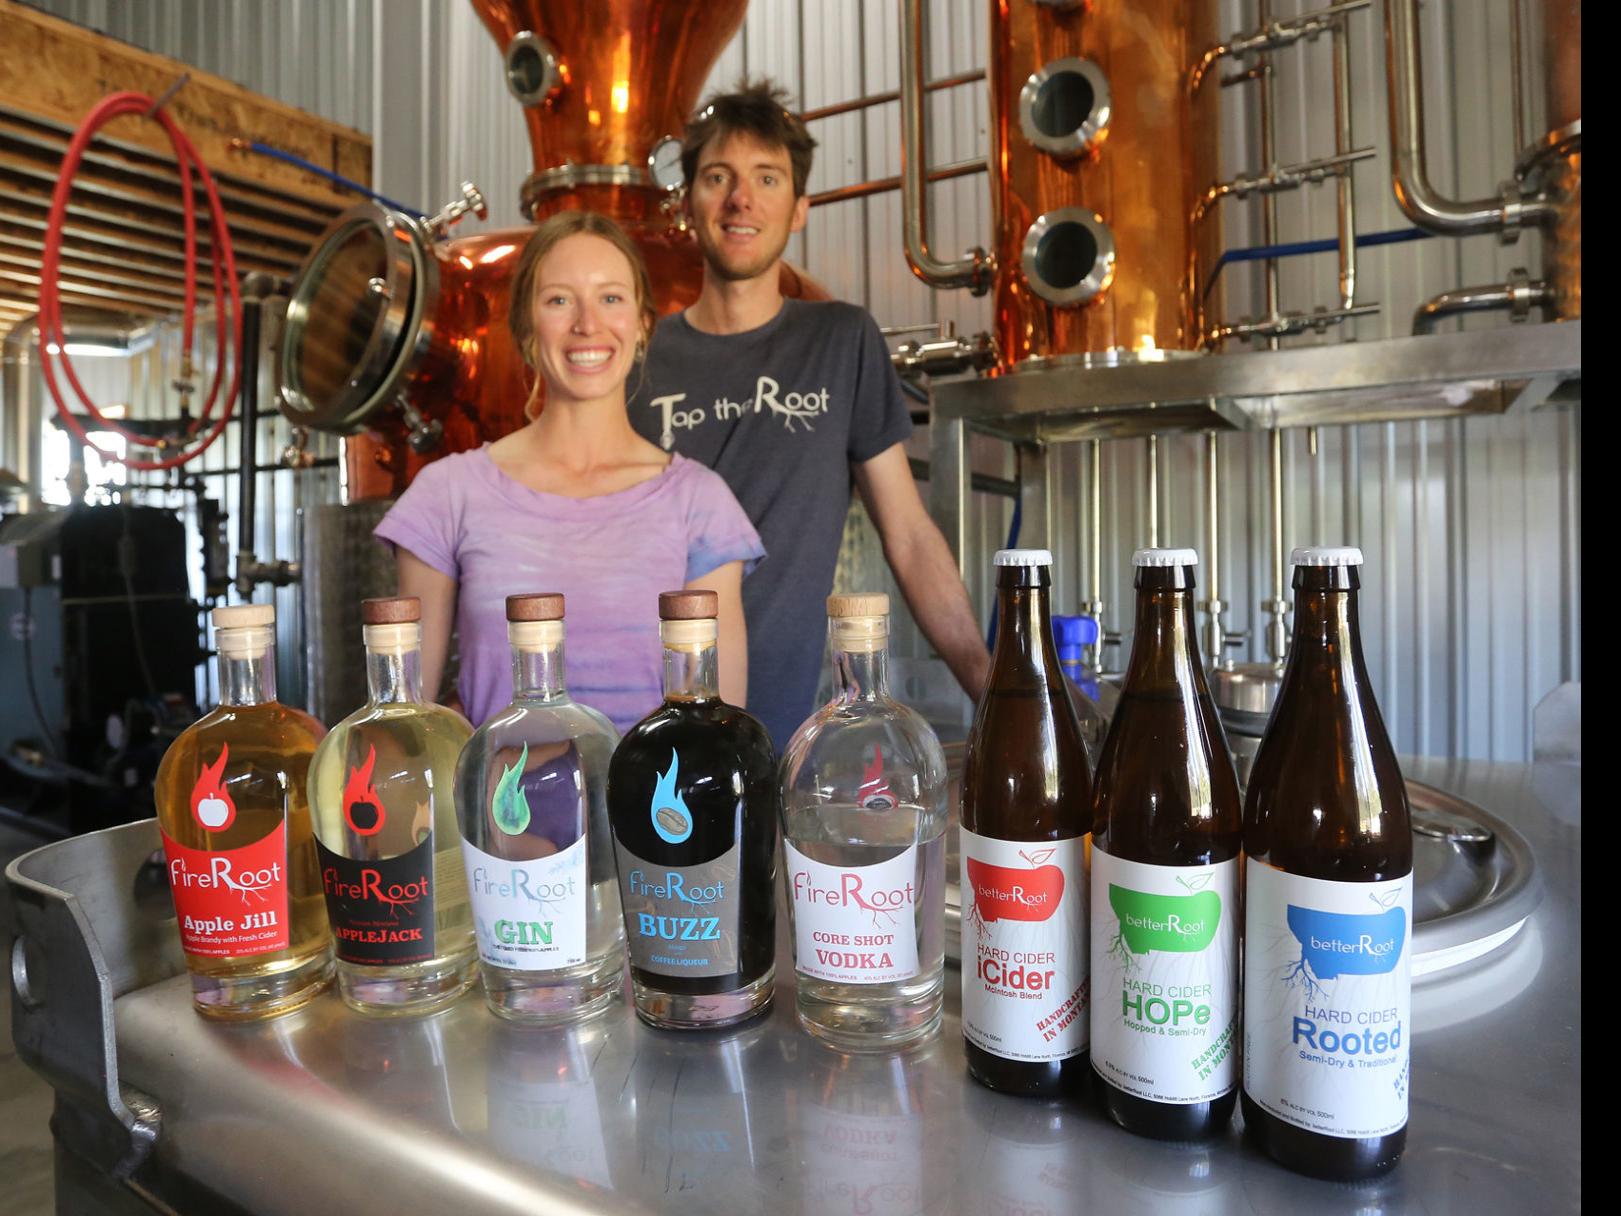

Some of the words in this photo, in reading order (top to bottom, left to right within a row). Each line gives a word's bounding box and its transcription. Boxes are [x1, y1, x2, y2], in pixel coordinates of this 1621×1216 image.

[650, 393, 706, 447] Tap
[754, 376, 830, 423] Root
[979, 884, 1047, 906] betterRoot
[184, 915, 234, 935] Apple
[240, 910, 278, 930] Jill
[494, 920, 554, 945] GIN
[638, 913, 721, 941] BUZZ
[1126, 913, 1205, 935] betterRoot
[223, 935, 238, 943] with
[239, 934, 258, 943] Fresh
[258, 931, 278, 940] Cider
[336, 928, 424, 943] APPLEJACK
[813, 931, 850, 946] CORE
[854, 934, 895, 947] SHOT
[1311, 935, 1394, 956] betterRoot
[816, 949, 894, 969] VODKA
[977, 944, 1010, 962] HARD
[1013, 952, 1056, 964] CIDER
[977, 956, 1055, 991] iCider
[984, 984, 1018, 998] McIntosh
[1019, 990, 1042, 1000] Blend
[1123, 977, 1163, 996] HARD
[1168, 984, 1211, 998] CIDER
[1122, 990, 1211, 1026] HOPe
[1305, 1005, 1352, 1024] HARD
[1357, 1008, 1398, 1024] CIDER
[1043, 1028, 1057, 1042] IN
[1123, 1019, 1156, 1034] Hopped
[1158, 1026, 1165, 1035] &
[1168, 1027, 1206, 1037] Semi-Dry
[1292, 1016, 1401, 1055] Rooted
[1299, 1050, 1345, 1068] Semi-Dry
[1347, 1060, 1355, 1068] &
[1199, 1065, 1211, 1080] IN
